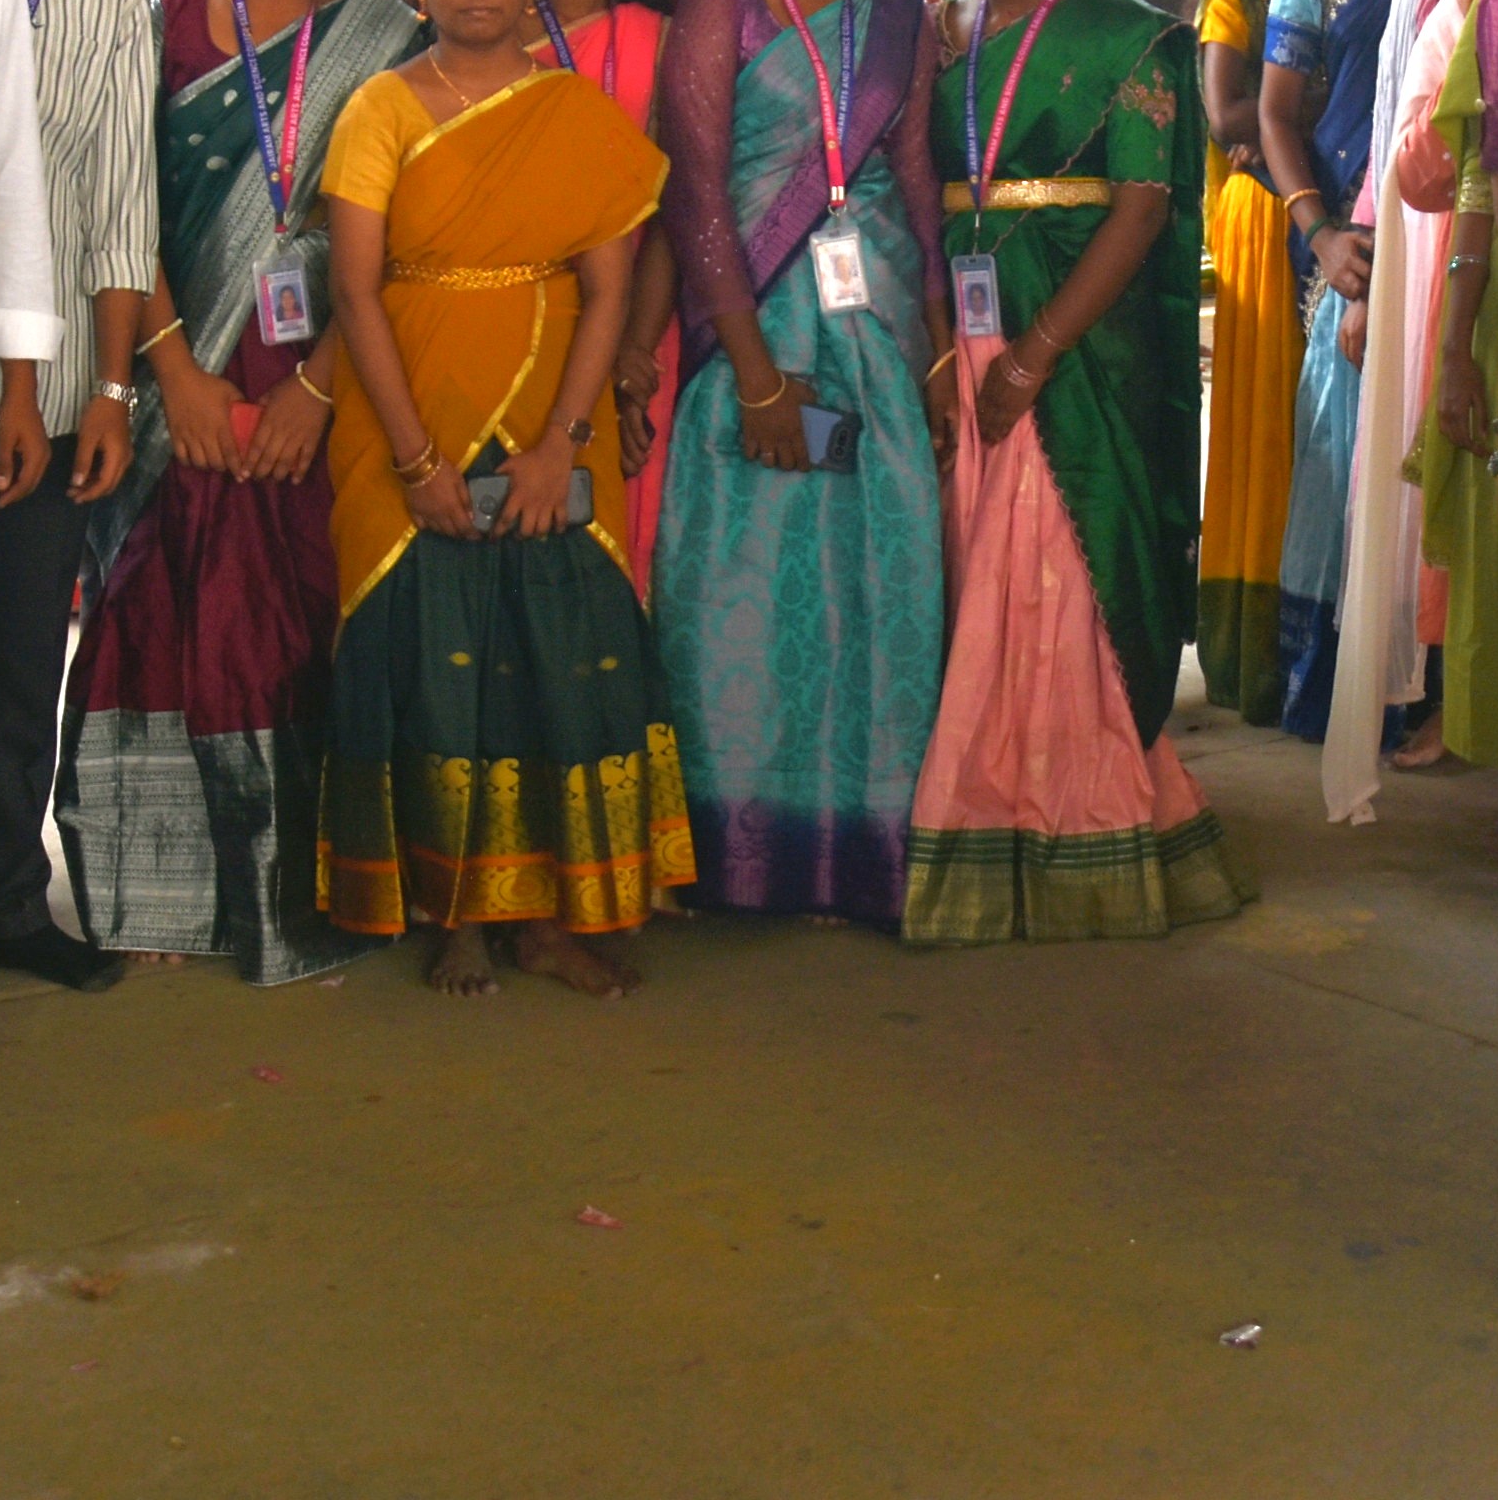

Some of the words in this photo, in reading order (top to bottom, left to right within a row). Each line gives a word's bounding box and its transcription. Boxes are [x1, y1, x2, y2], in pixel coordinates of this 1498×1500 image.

[249, 59, 263, 90] SCIENCE
[814, 61, 825, 79] AND
[842, 71, 850, 89] AND
[255, 91, 266, 109] AND
[293, 82, 303, 101] AND
[820, 79, 829, 102] ARTS
[839, 90, 849, 112] ARTS
[259, 111, 270, 133] ARTS
[290, 102, 300, 125] ARTS
[824, 102, 834, 136] JAIRAM
[966, 117, 975, 138] ARTS
[986, 139, 998, 170] JAIRAM
[992, 117, 1004, 138] ARTS
[999, 97, 1011, 115] AND
[264, 134, 277, 168] JAIRAM
[286, 127, 297, 160] JAIRAM
[969, 140, 978, 171] JAIRAM
